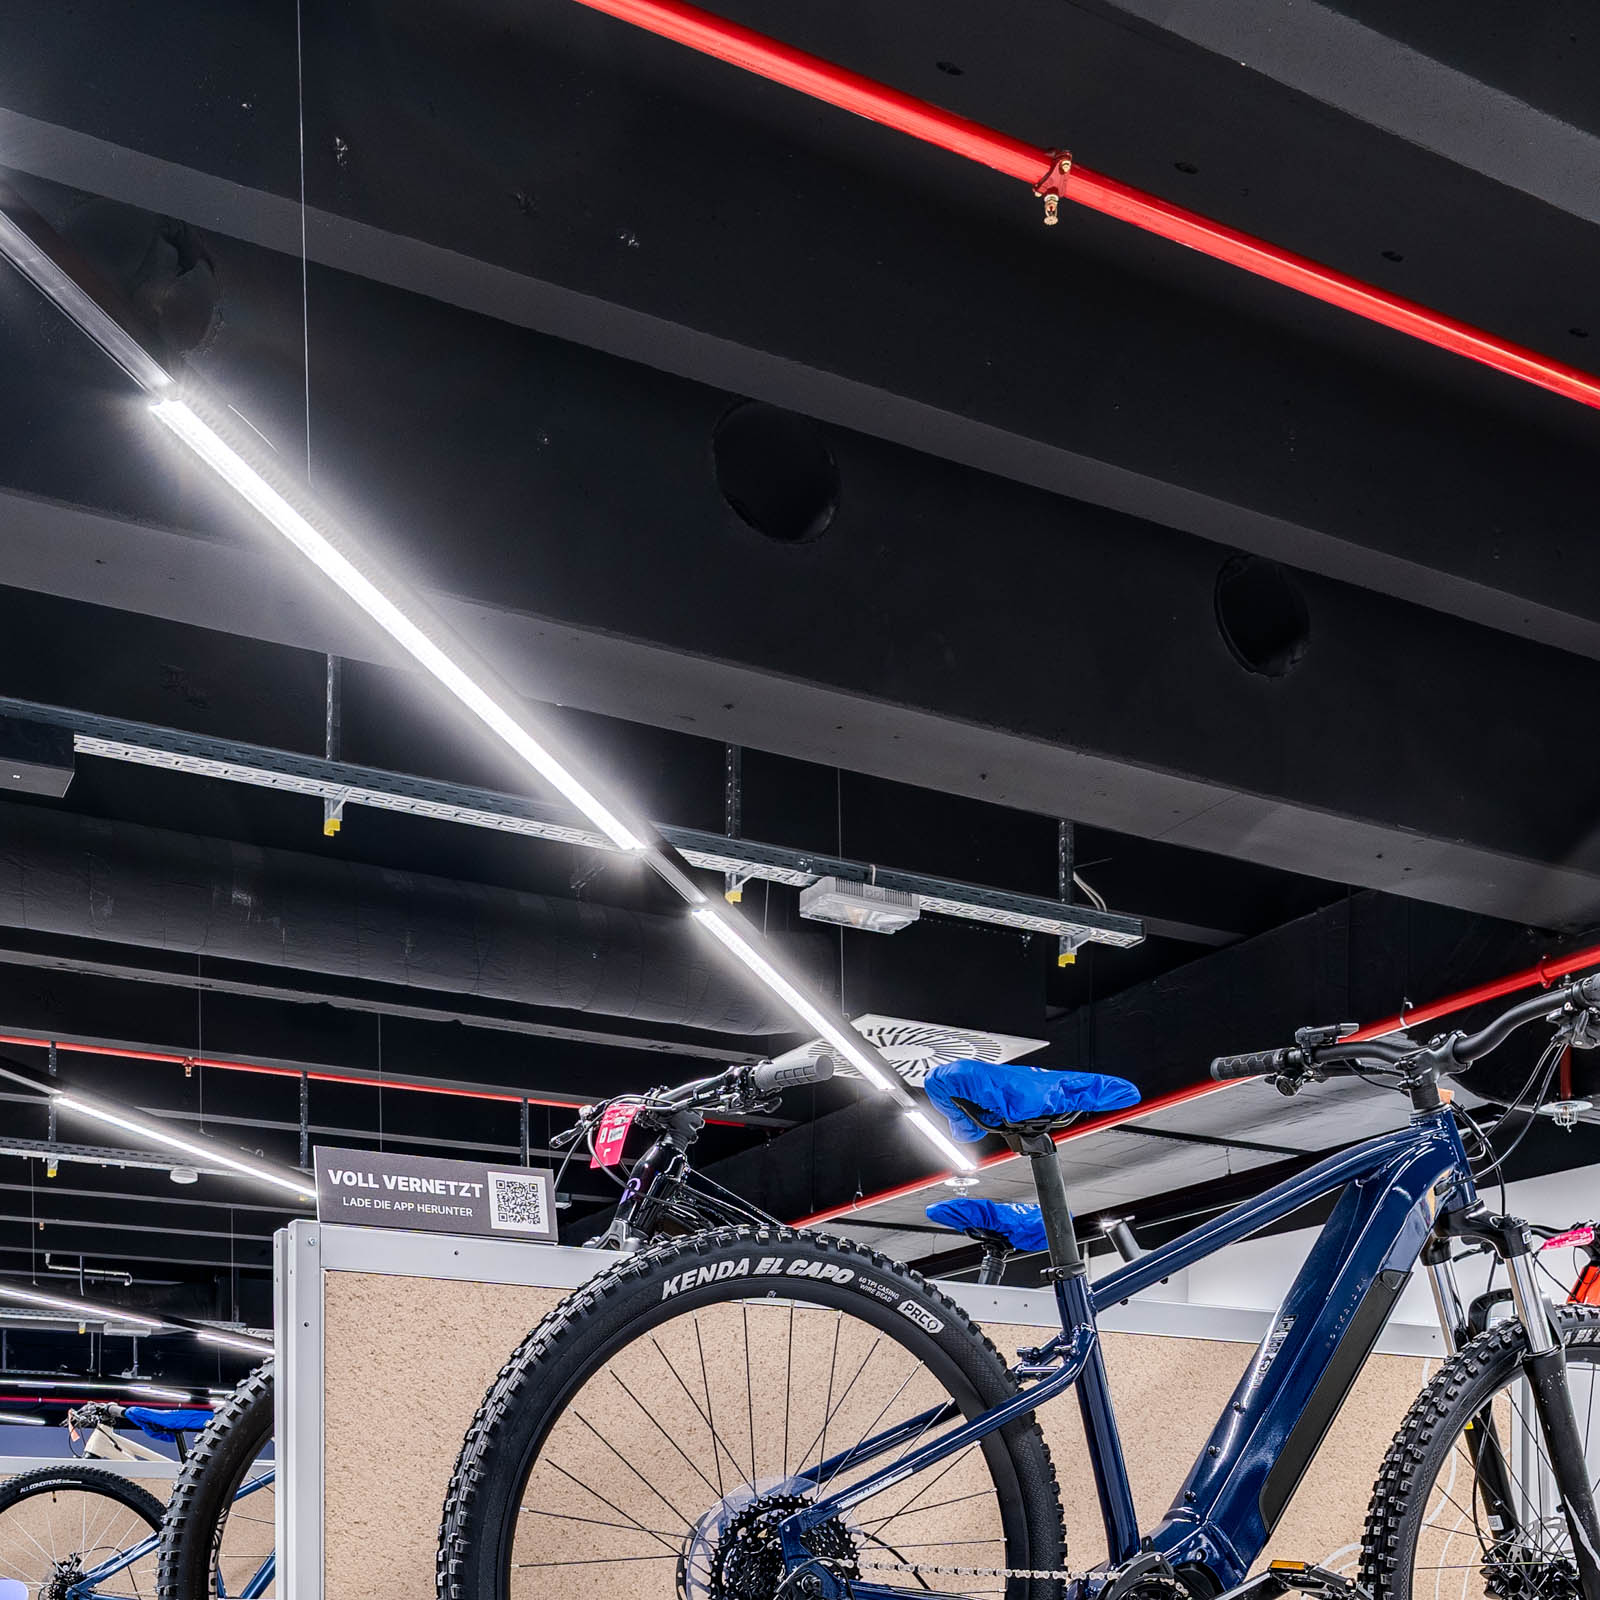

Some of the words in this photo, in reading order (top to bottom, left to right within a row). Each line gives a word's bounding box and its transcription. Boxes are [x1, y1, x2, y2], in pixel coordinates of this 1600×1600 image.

[328, 1169, 379, 1189] VOLL
[382, 1174, 483, 1198] VERNETZT
[343, 1196, 371, 1208] LADE
[374, 1199, 390, 1210] DIE
[393, 1201, 415, 1212] APP
[417, 1203, 473, 1217] HERUNTER
[662, 1257, 750, 1300] KENDA
[753, 1257, 783, 1275] EL
[786, 1259, 855, 1285] CAPO
